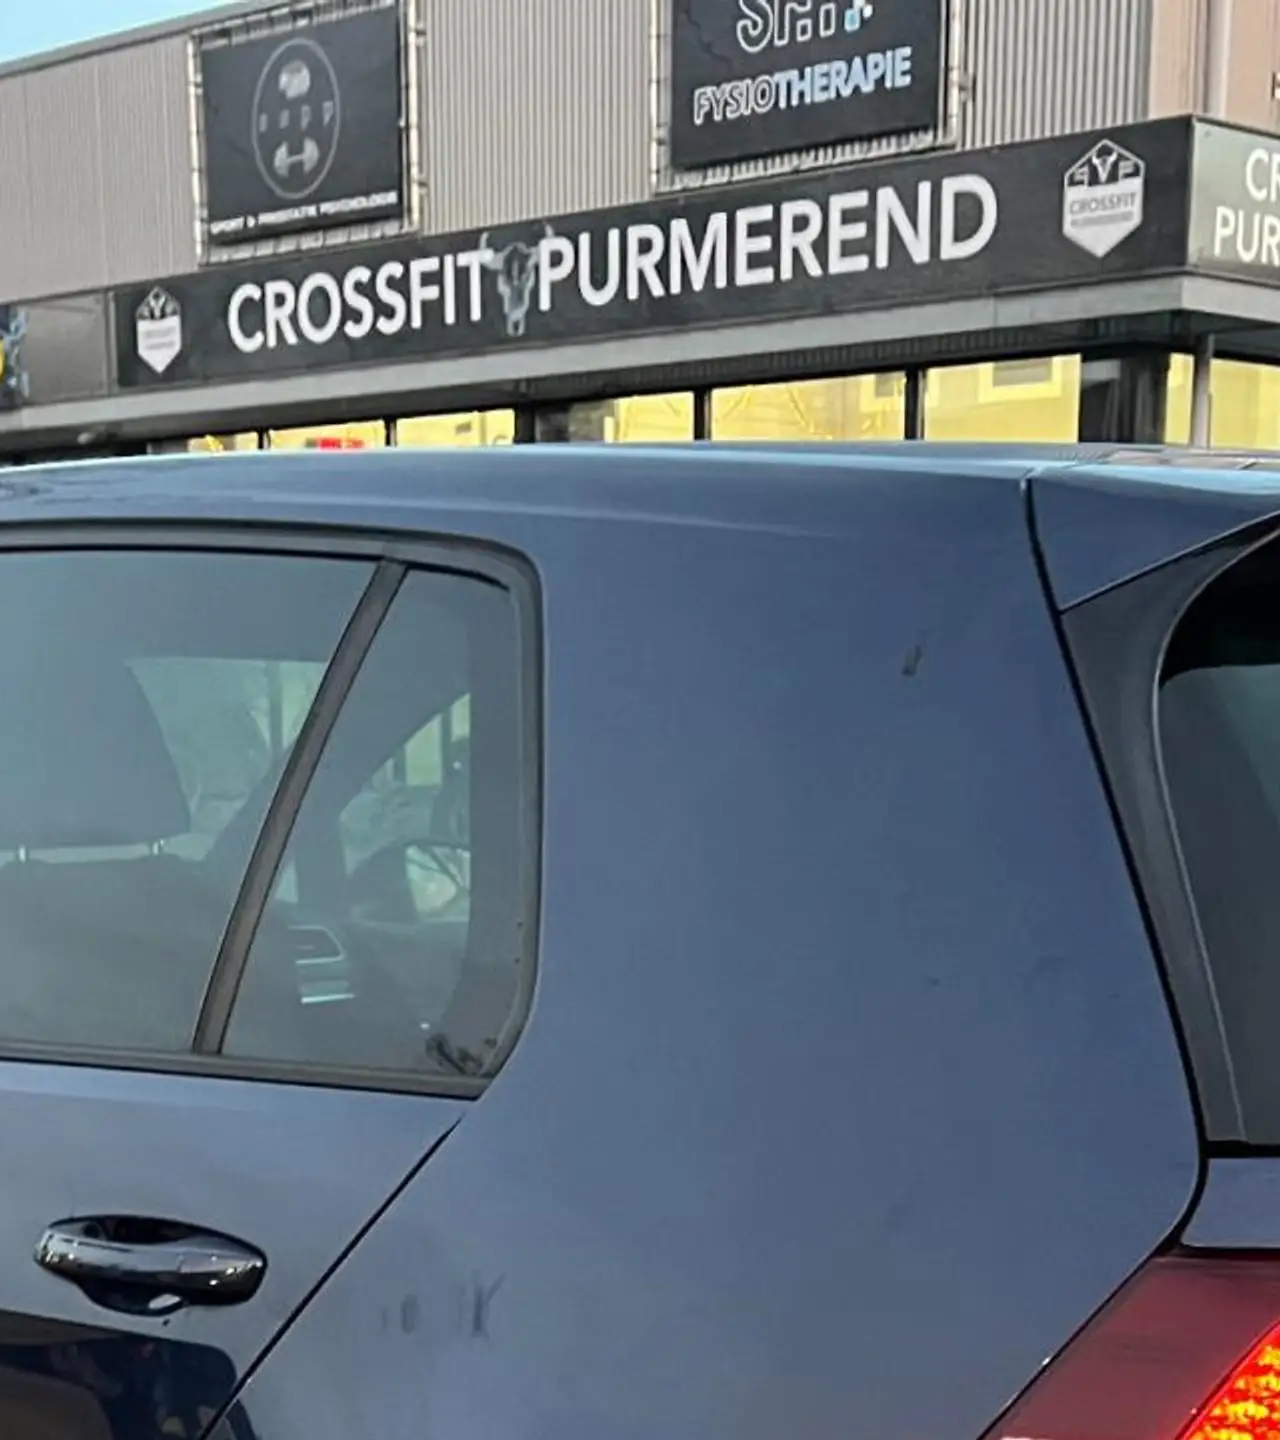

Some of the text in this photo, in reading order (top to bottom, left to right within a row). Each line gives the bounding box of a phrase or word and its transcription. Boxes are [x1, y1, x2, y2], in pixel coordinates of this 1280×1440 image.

[693, 46, 913, 126] FYSIOTHERAPIE
[227, 173, 999, 354] CROSSFIT PURMEREND
